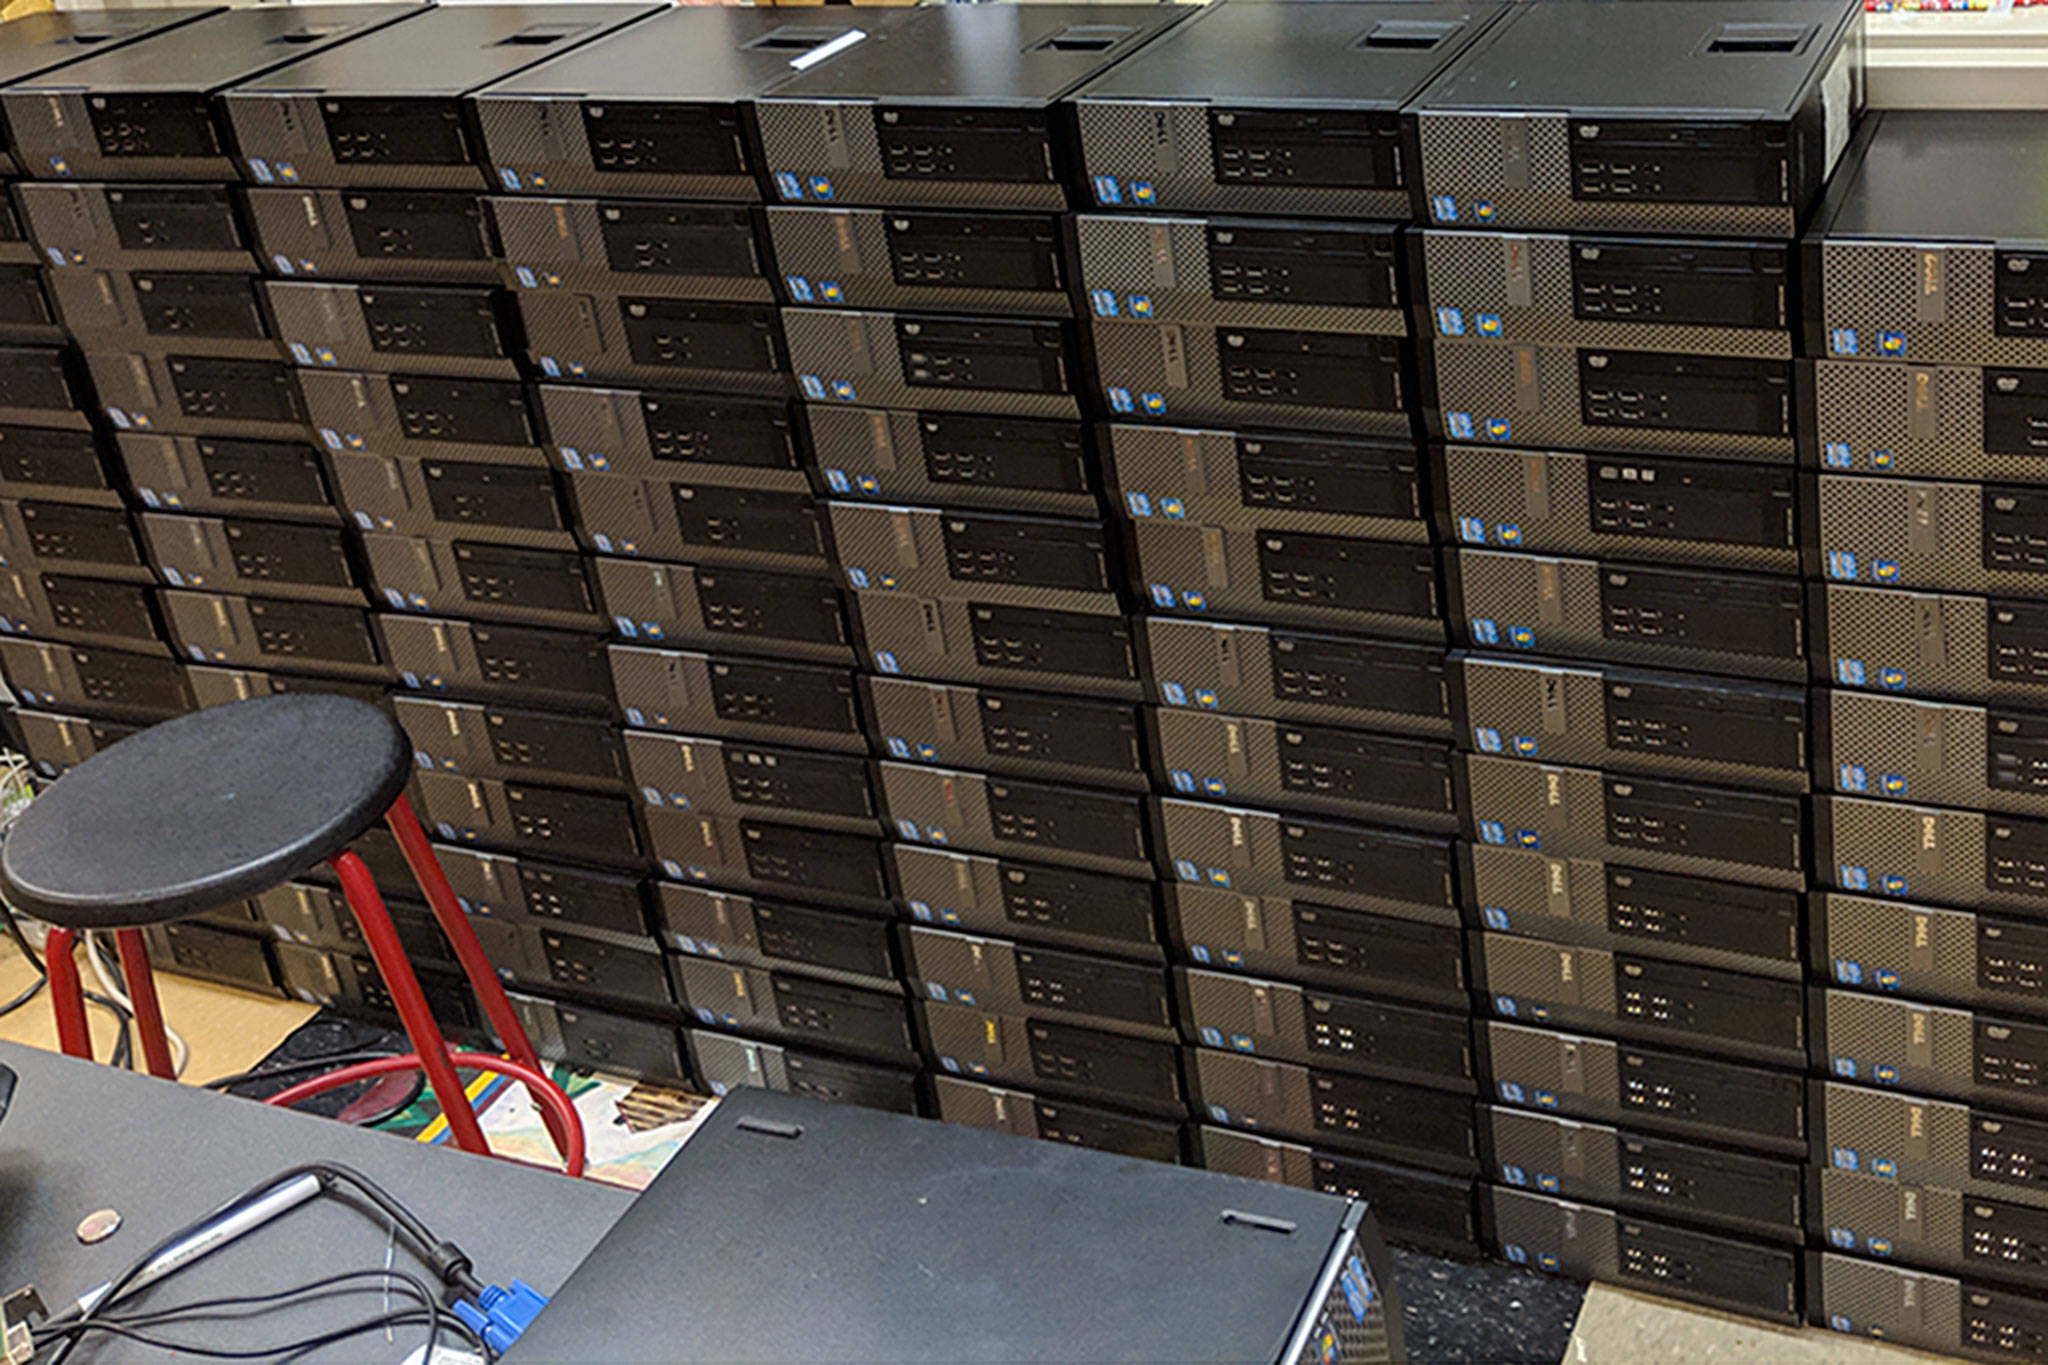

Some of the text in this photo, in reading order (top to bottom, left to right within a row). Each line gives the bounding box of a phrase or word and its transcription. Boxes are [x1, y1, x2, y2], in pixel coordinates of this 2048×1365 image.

[1227, 724, 1240, 753] DELL
[1548, 774, 1561, 806] DELL
[1231, 817, 1243, 846] DELL
[1922, 817, 1936, 850] DELL
[1551, 864, 1564, 895] DELL
[1245, 901, 1256, 929] DELL
[1915, 916, 1928, 948] DELL
[1560, 952, 1573, 982] DELL
[1913, 1013, 1925, 1045] DELL
[1910, 1107, 1923, 1137] DELL
[1904, 1192, 1918, 1220] DELL
[1904, 1279, 1916, 1307] DELL
